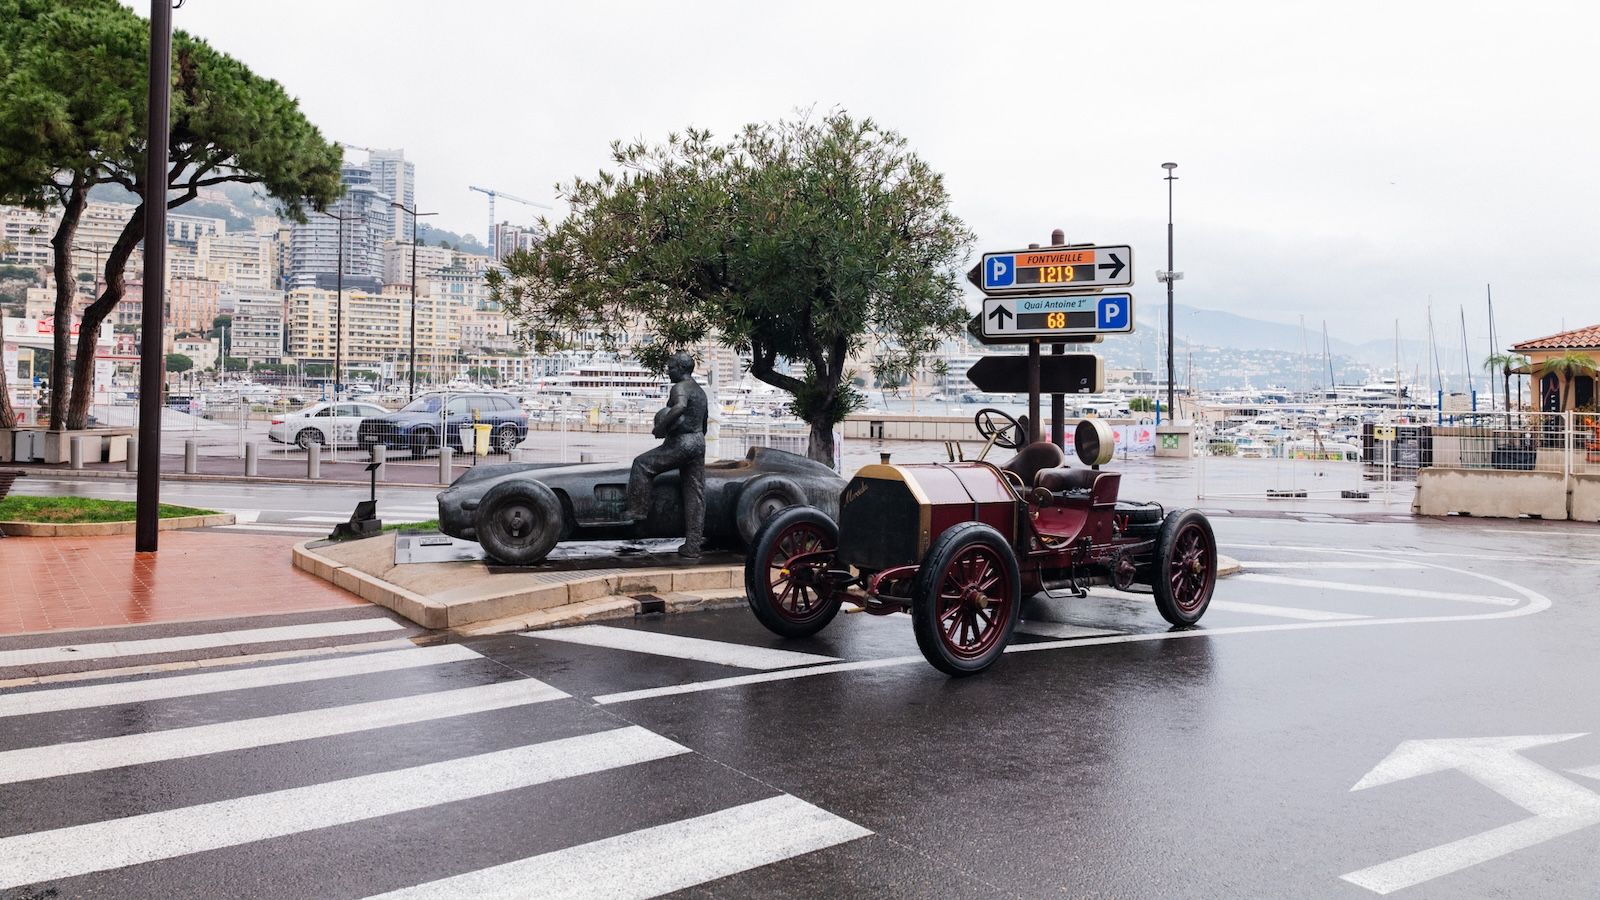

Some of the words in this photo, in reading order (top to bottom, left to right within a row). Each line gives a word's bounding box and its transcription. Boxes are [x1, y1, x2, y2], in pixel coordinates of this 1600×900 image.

[1027, 253, 1083, 264] FONTVIEILLE
[993, 261, 1007, 281] P
[1039, 266, 1074, 283] 1219
[1024, 301, 1043, 310] Quai
[1044, 301, 1076, 310] Antoine
[1105, 303, 1120, 323] P
[1047, 312, 1065, 329] 68
